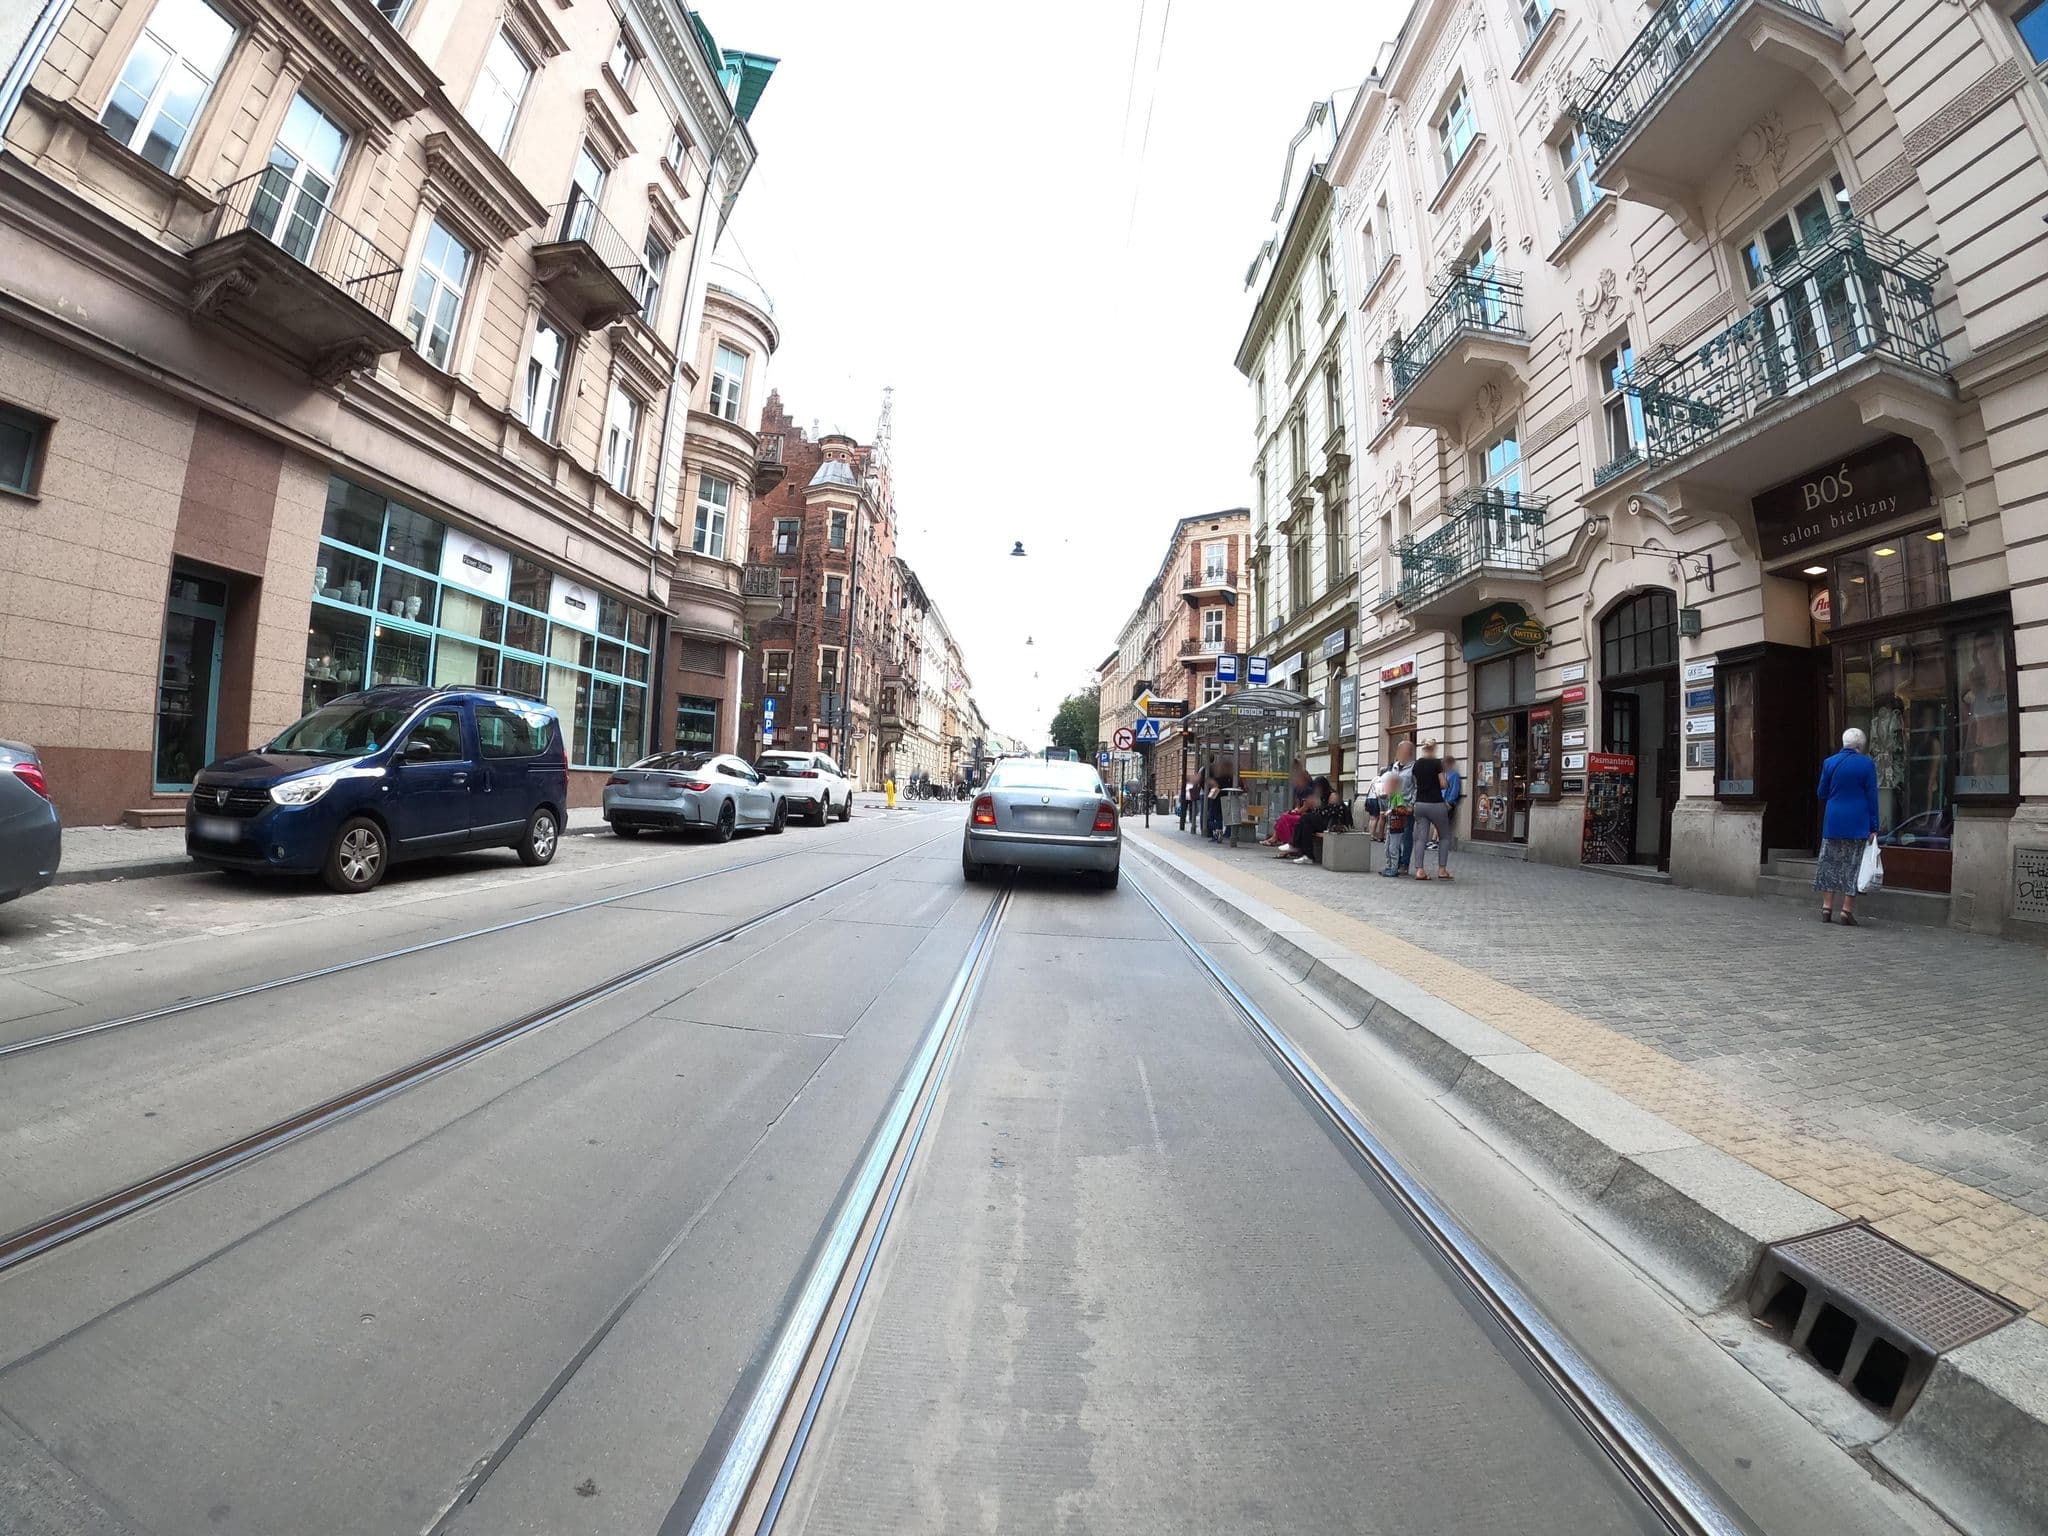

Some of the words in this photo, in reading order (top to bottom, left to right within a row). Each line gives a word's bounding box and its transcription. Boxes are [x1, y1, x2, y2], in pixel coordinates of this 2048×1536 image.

[1801, 463, 1853, 511] BOŚ
[1782, 524, 1820, 545] salon
[1830, 496, 1896, 528] bielizny
[1590, 755, 1634, 766] Pasmanteria
